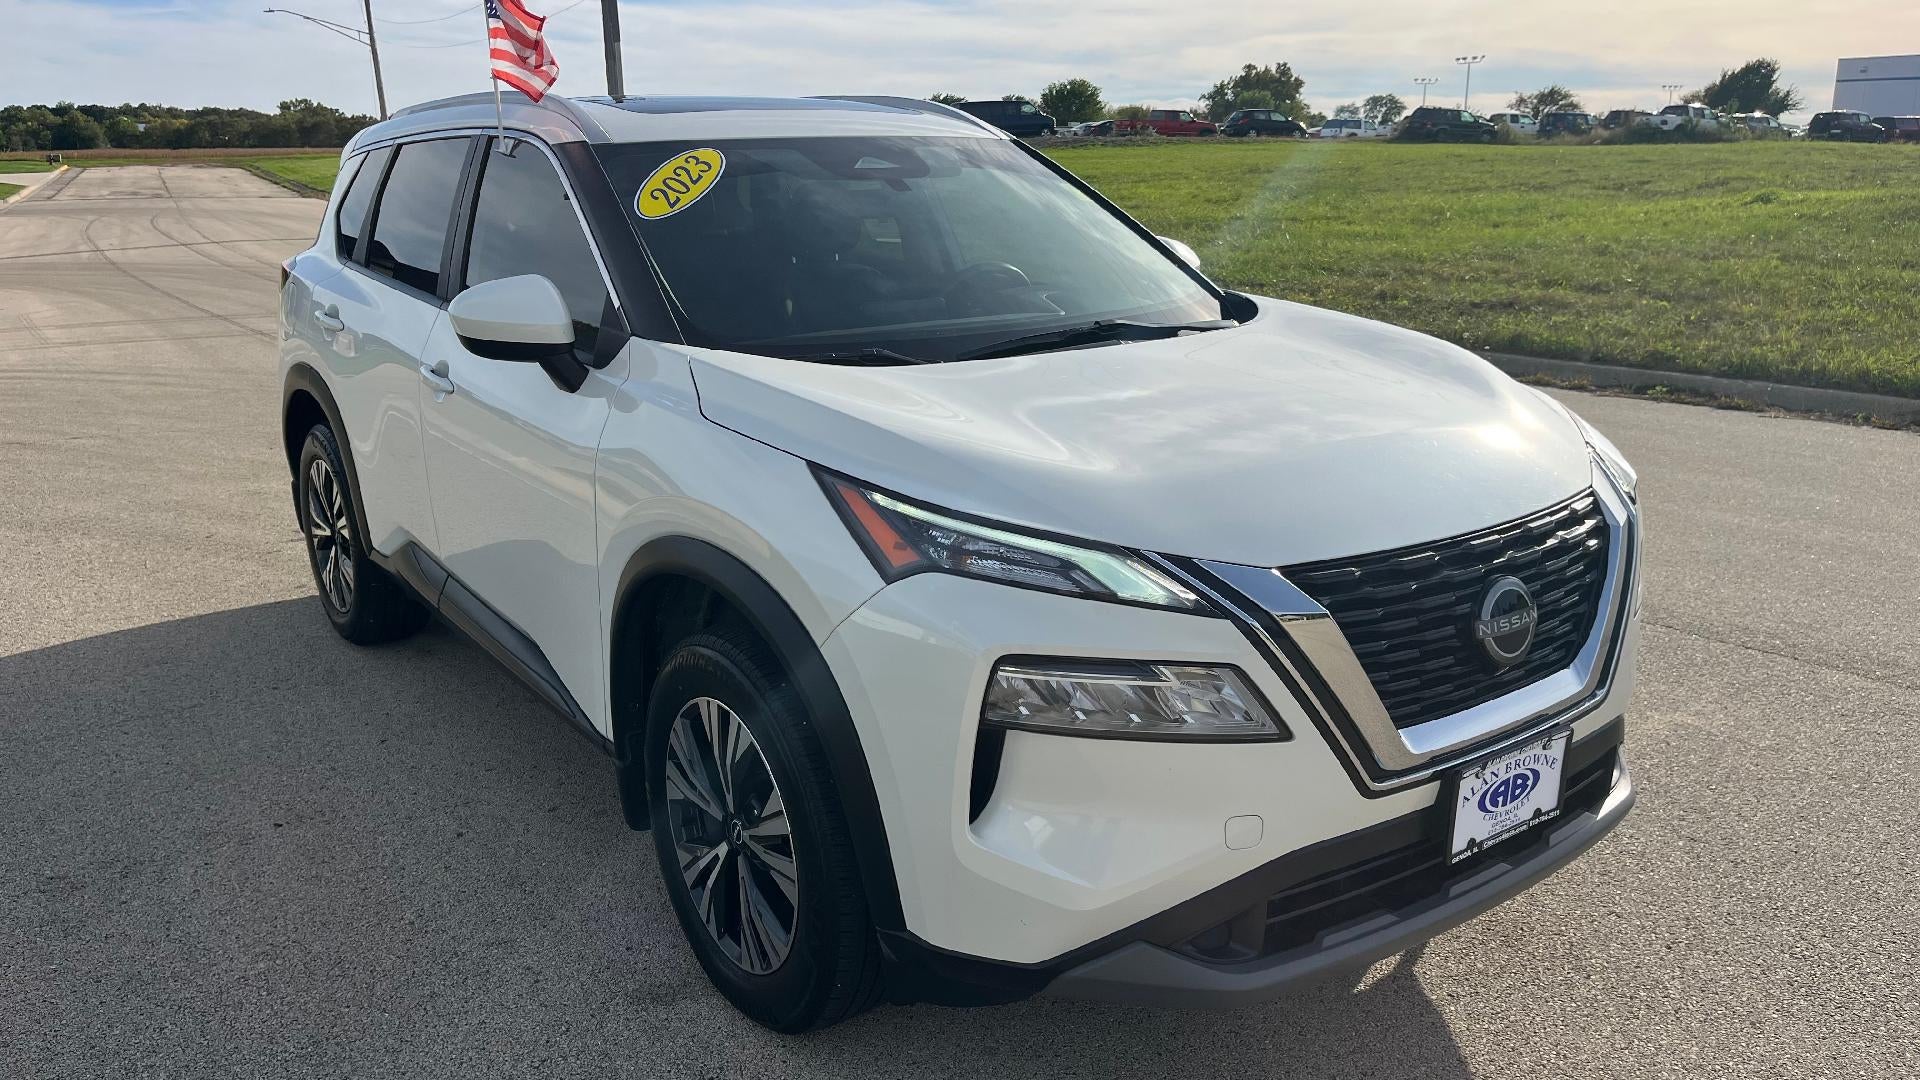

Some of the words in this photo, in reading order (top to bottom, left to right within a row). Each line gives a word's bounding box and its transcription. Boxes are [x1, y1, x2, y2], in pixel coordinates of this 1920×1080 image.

[651, 155, 712, 209] 2023
[1479, 609, 1537, 636] NISSAN
[1461, 768, 1500, 808] ALAN
[1504, 753, 1558, 775] BROWNE
[1482, 796, 1531, 822] CHEVROLET
